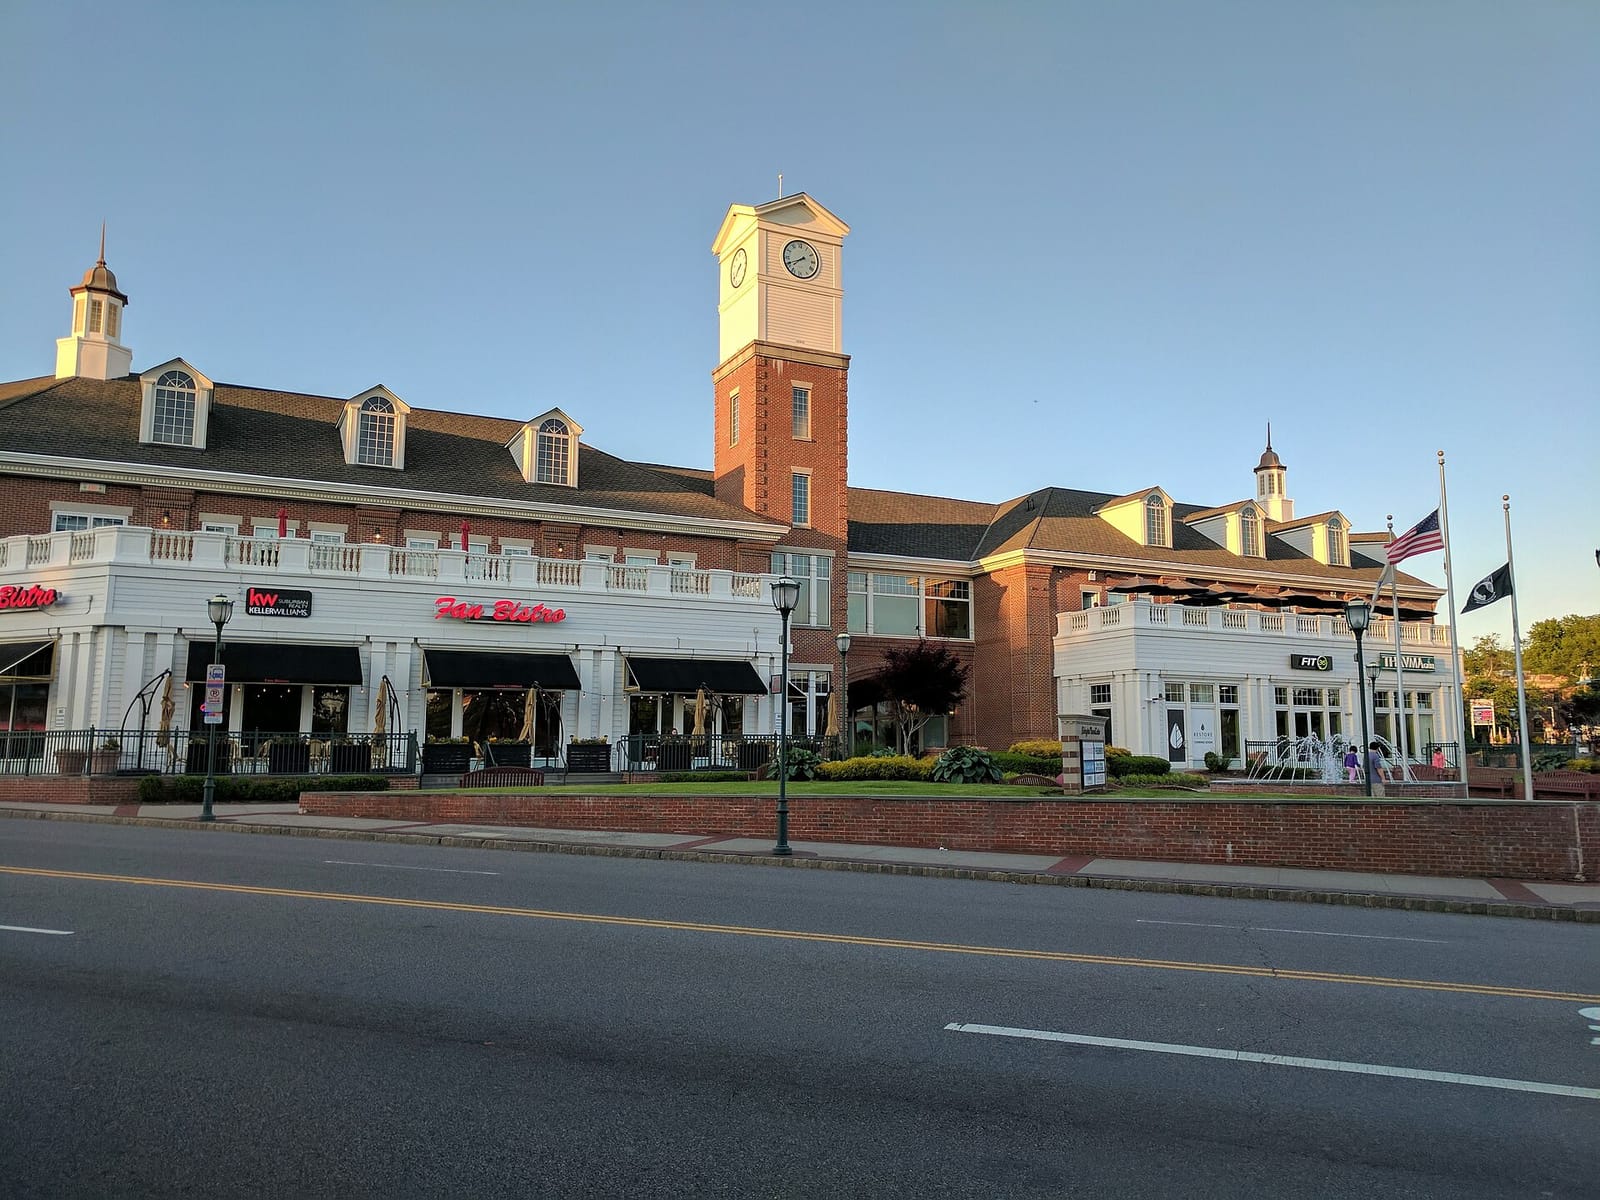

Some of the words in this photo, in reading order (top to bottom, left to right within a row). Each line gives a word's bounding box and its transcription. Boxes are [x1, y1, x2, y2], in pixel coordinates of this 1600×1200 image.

[0, 584, 57, 608] Bistro
[435, 596, 484, 619] Fan
[493, 599, 566, 623] Bistro
